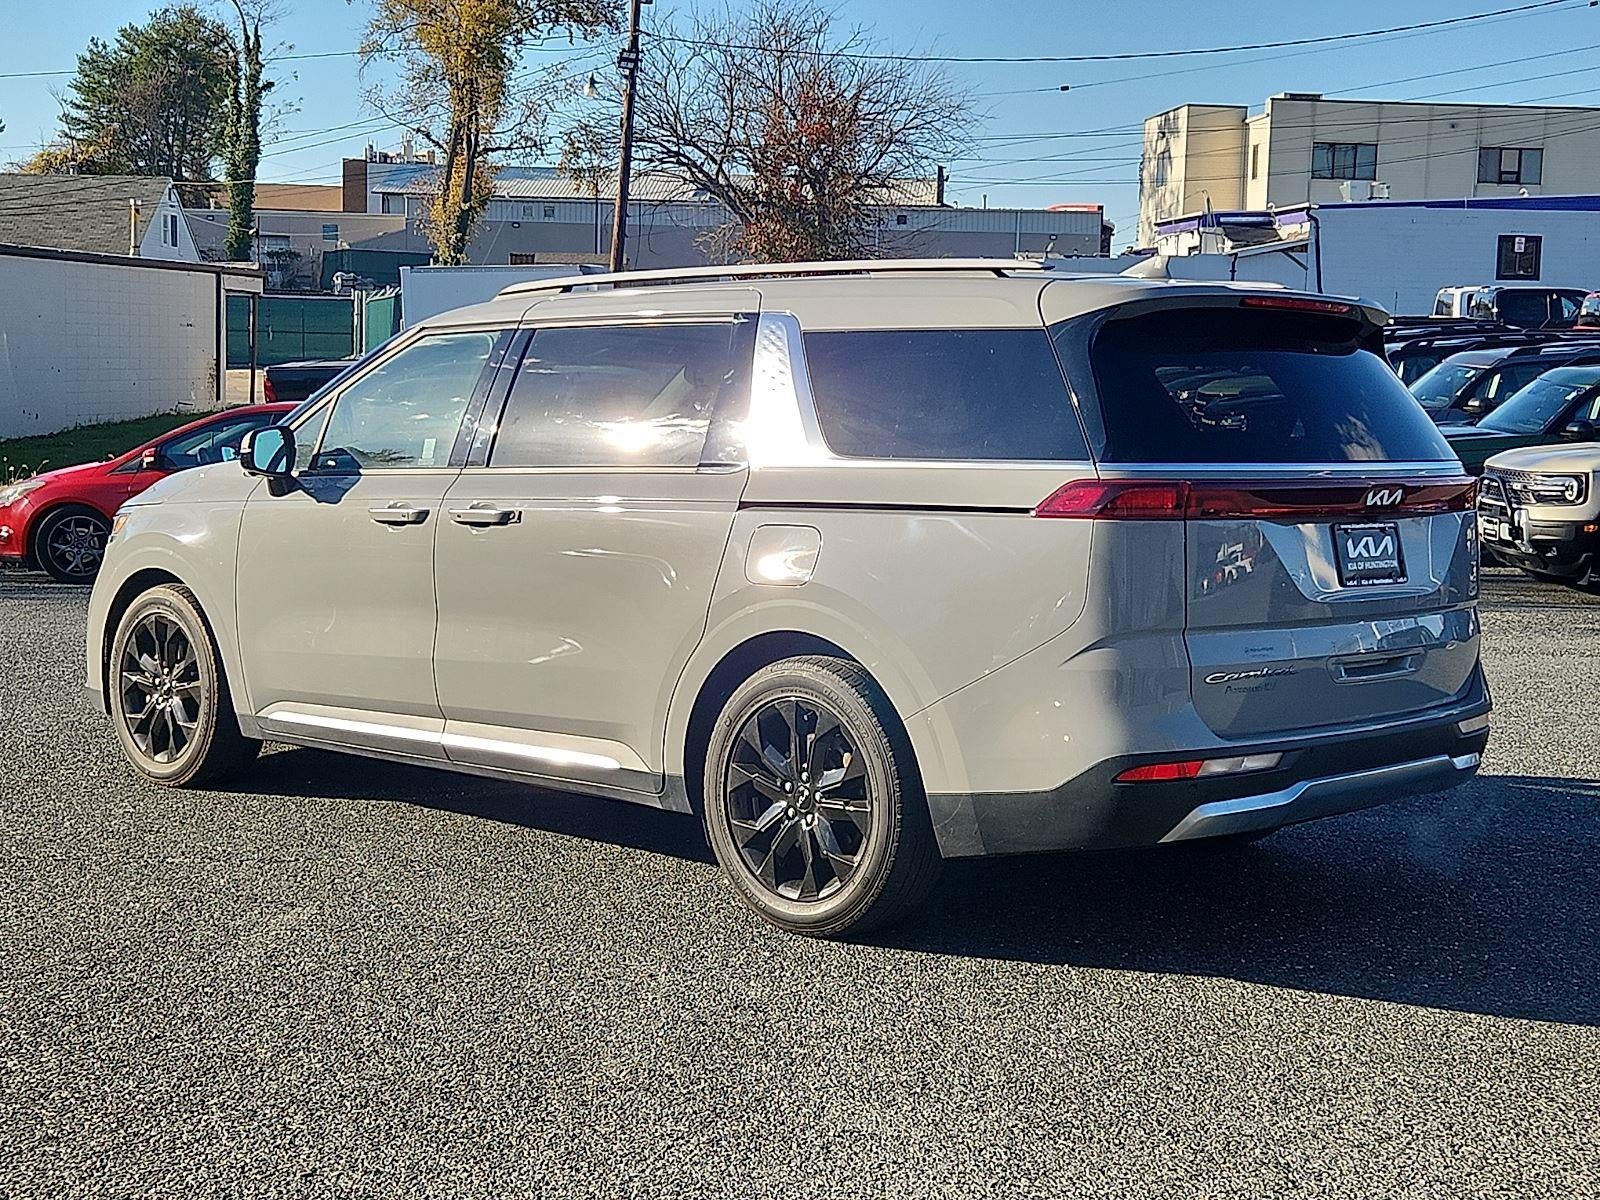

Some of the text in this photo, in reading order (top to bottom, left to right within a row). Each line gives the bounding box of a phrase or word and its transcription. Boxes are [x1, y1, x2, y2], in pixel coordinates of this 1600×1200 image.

[1366, 489, 1403, 506] KIA
[1347, 536, 1394, 558] KIA
[1348, 560, 1398, 570] KIA OF HUNTINGTON
